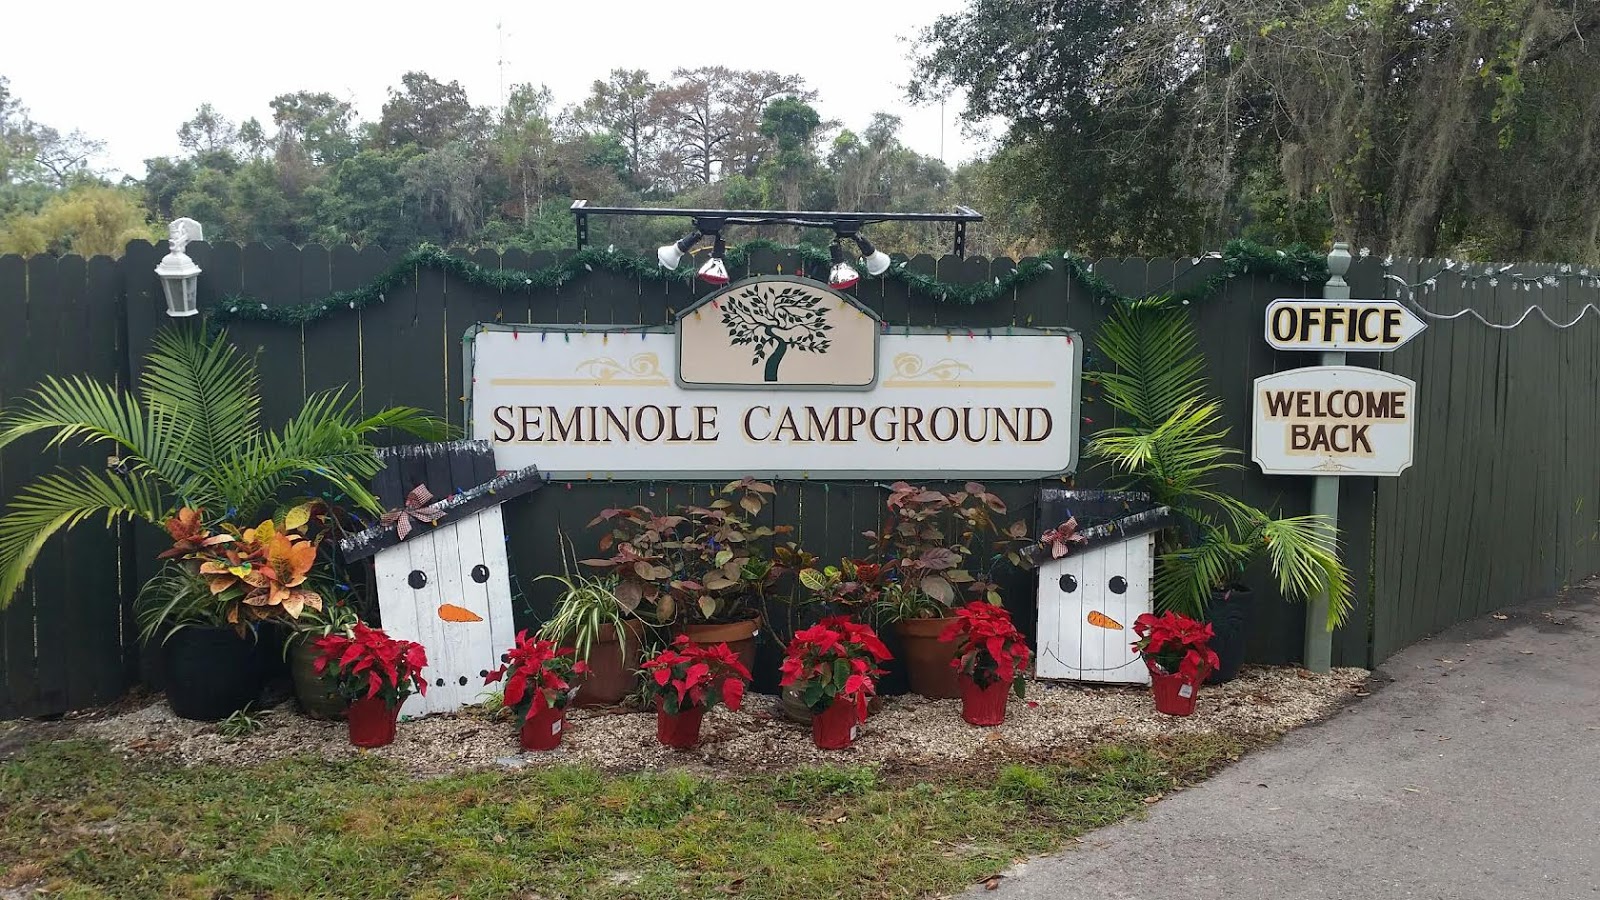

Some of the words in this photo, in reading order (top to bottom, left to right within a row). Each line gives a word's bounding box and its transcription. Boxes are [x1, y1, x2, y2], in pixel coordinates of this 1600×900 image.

[1272, 307, 1402, 343] OFFICE
[1265, 389, 1407, 419] WELCOME
[493, 405, 720, 443] SEMINOLE
[744, 405, 1053, 443] CAMPGROUND
[1291, 424, 1373, 453] BACK
